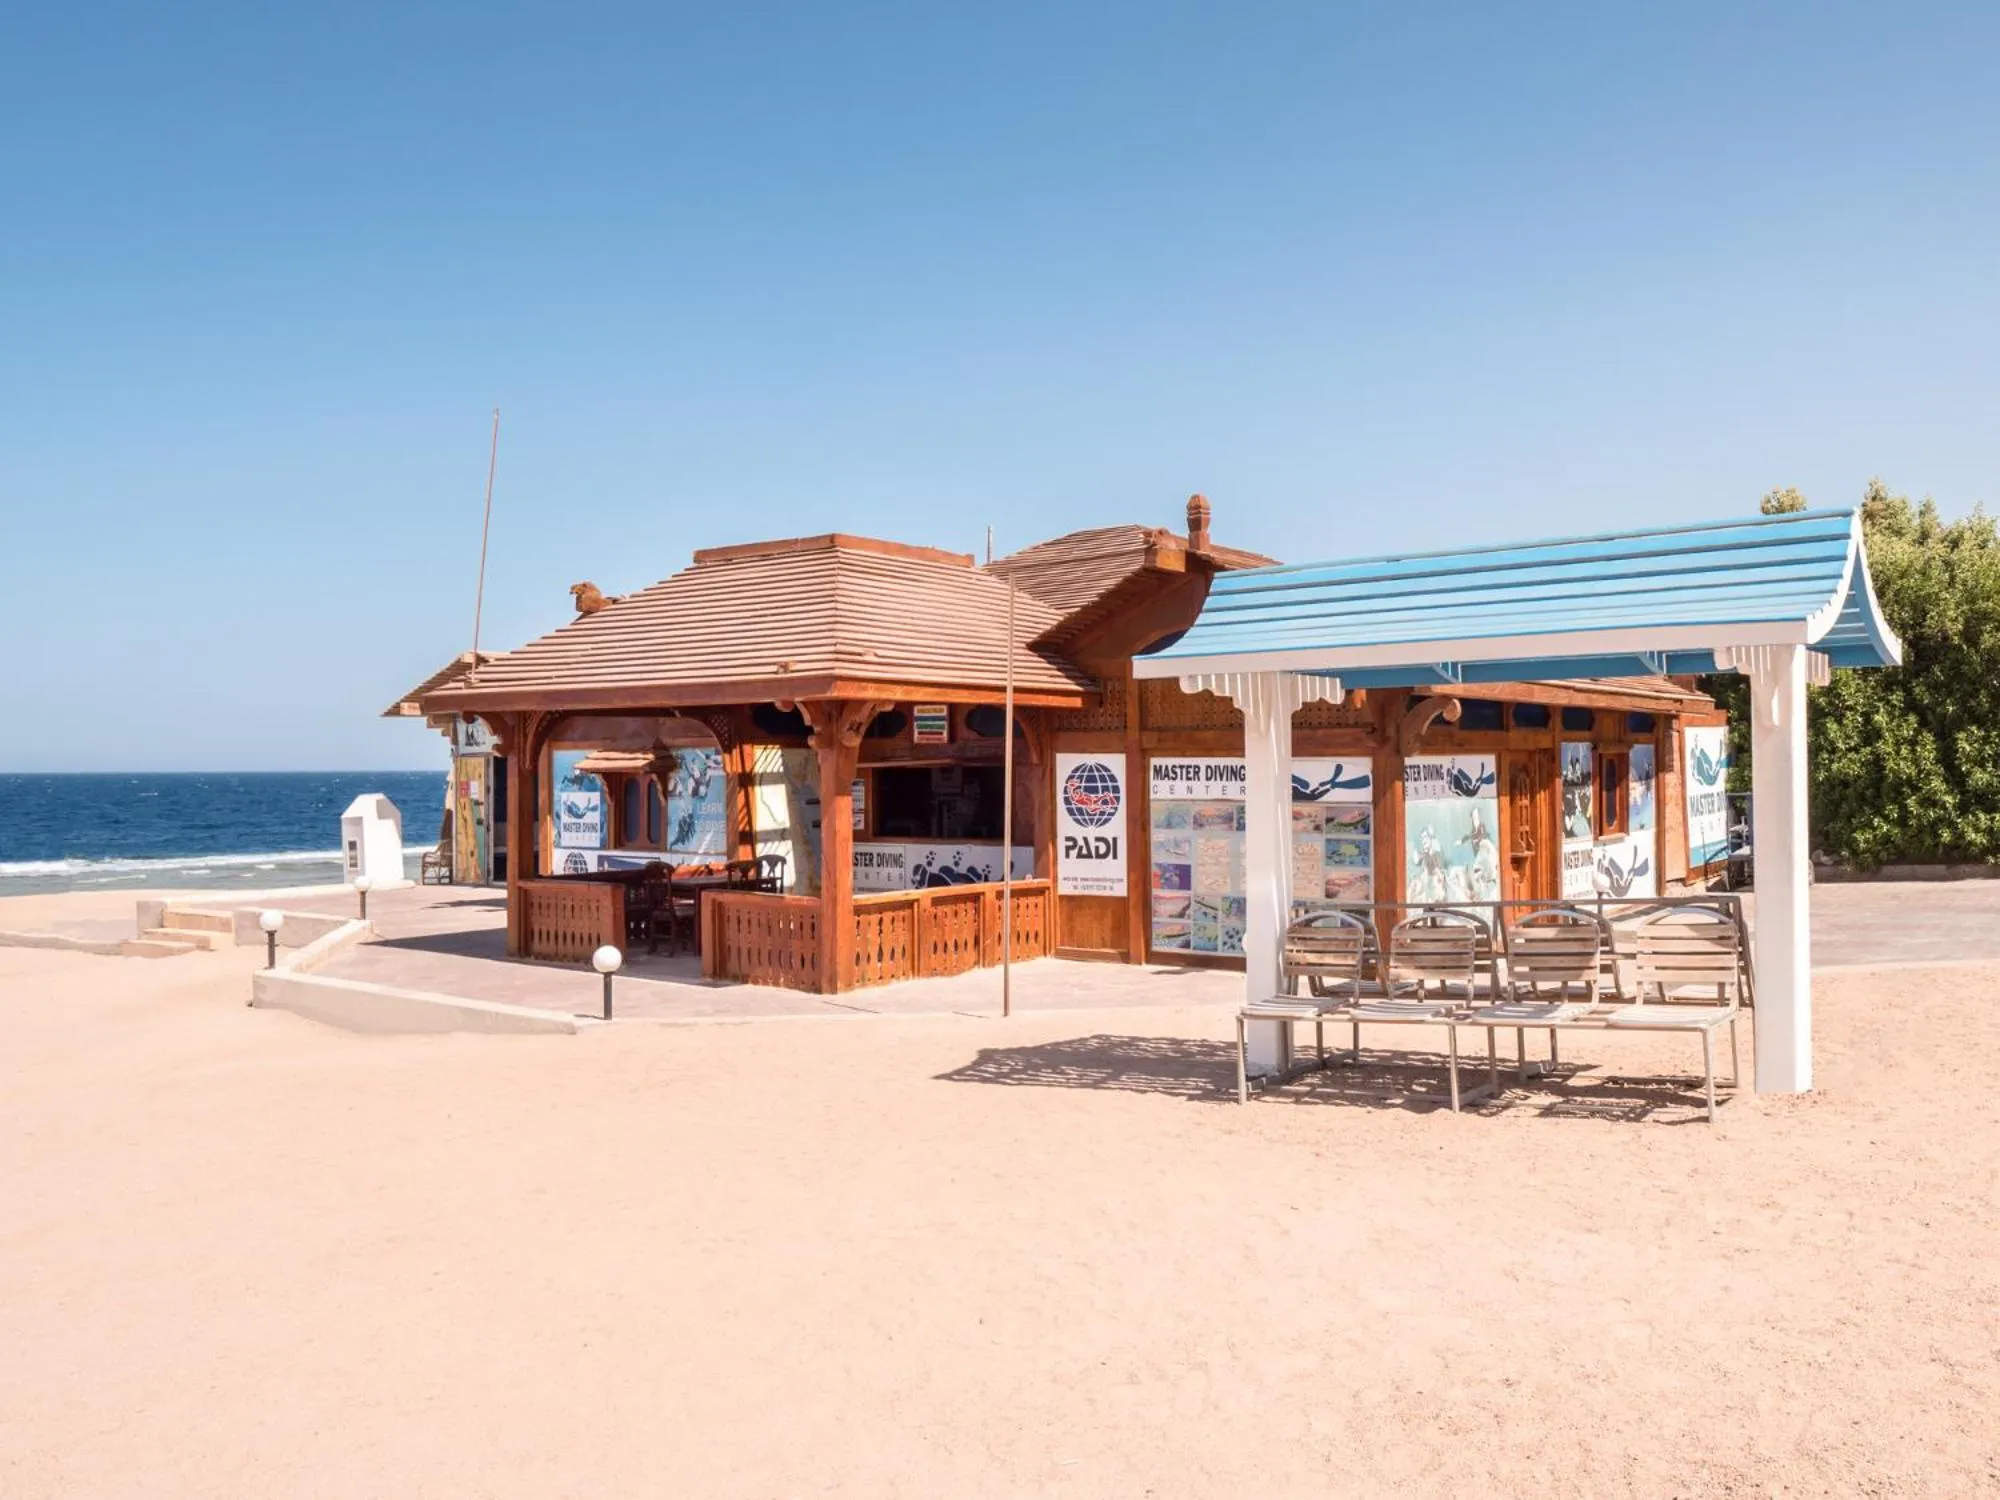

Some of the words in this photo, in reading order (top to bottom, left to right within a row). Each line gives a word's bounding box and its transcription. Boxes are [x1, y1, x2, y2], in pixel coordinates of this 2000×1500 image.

[1153, 764, 1200, 782] MASTER
[1205, 764, 1246, 782] DIVING
[1404, 764, 1422, 782] STER
[1422, 764, 1444, 781] DIVING
[1153, 784, 1246, 796] CENTER
[1404, 783, 1445, 796] ENTER
[1690, 792, 1715, 818] MASTER
[563, 822, 581, 833] MASTER
[582, 822, 598, 833] DIVING
[1065, 836, 1118, 860] PADI
[854, 851, 874, 868] STER
[876, 852, 904, 868] DIVING
[854, 871, 904, 882] ENTER
